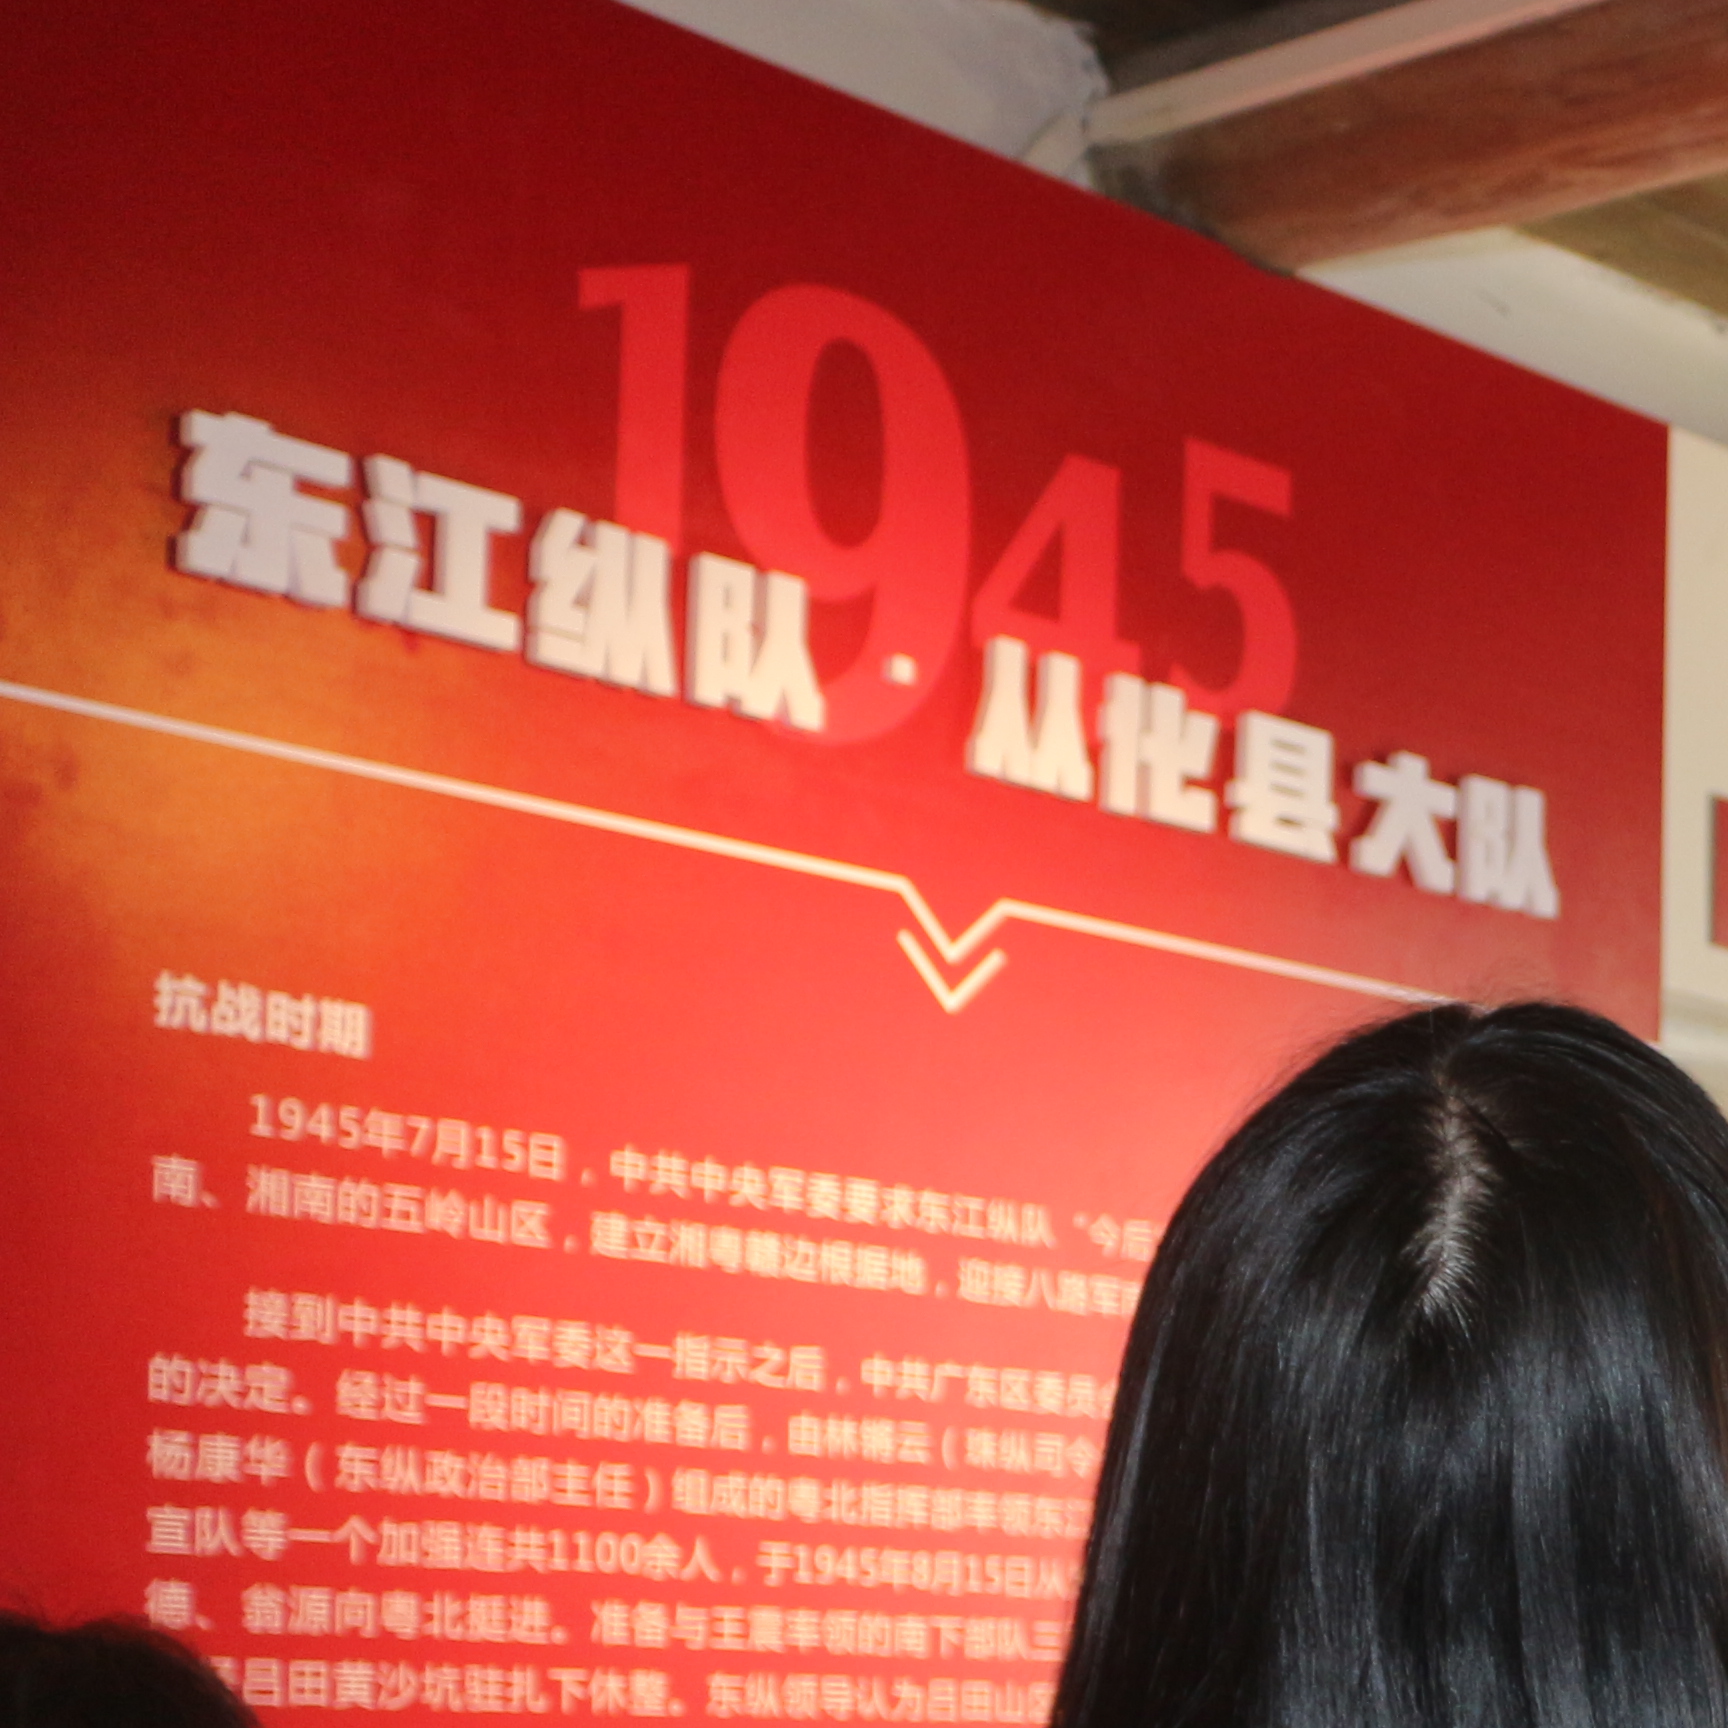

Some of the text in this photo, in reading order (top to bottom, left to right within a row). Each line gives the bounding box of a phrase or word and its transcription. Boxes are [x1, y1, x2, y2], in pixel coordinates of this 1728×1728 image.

[577, 262, 1300, 746] 1945
[153, 969, 373, 1059] 抗战时期
